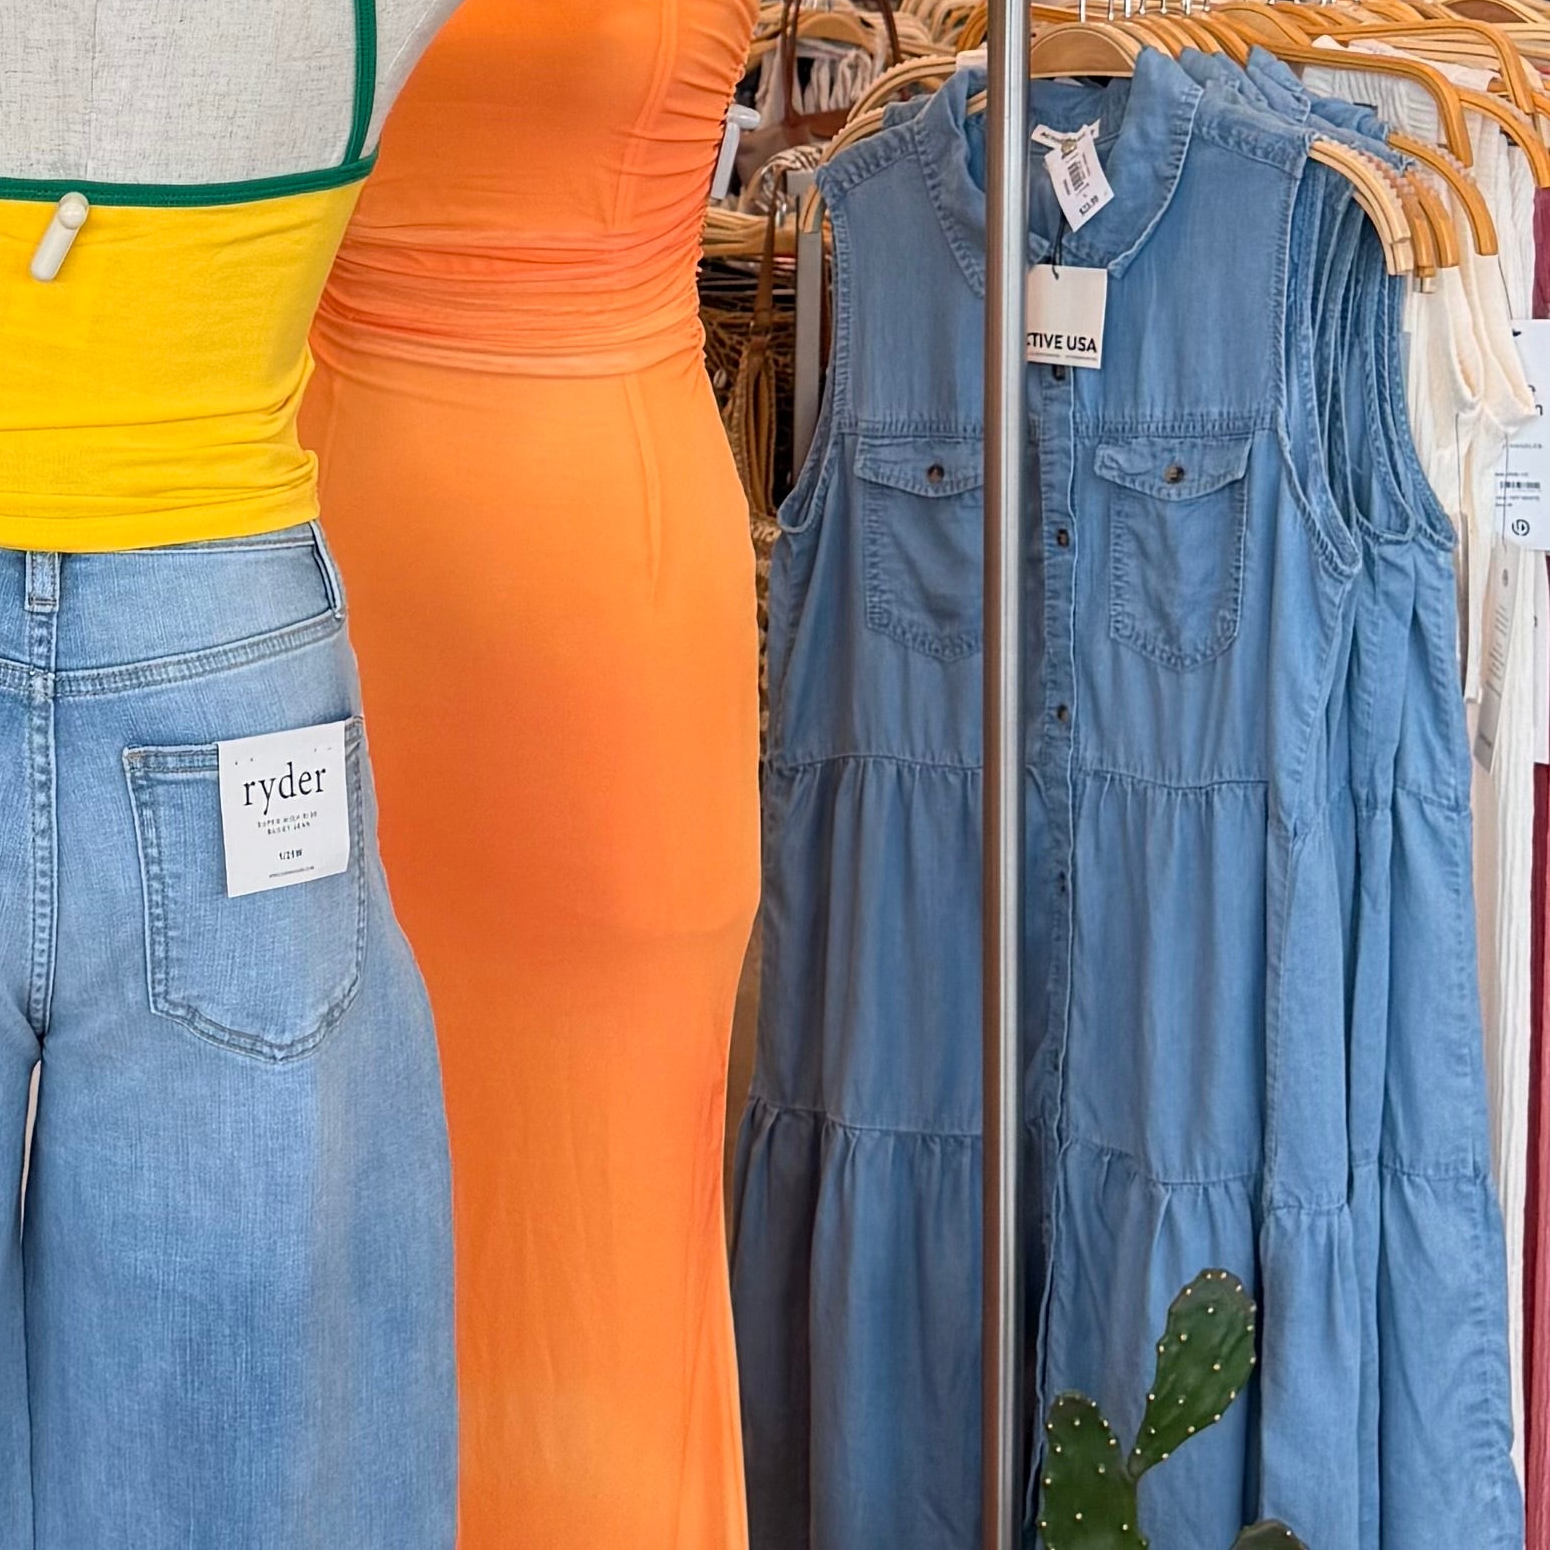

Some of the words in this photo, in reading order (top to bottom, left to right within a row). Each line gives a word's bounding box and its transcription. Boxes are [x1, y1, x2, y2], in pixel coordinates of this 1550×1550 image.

[1027, 333, 1062, 349] TIVE
[1067, 336, 1097, 352] USA
[244, 762, 325, 815] ryder
